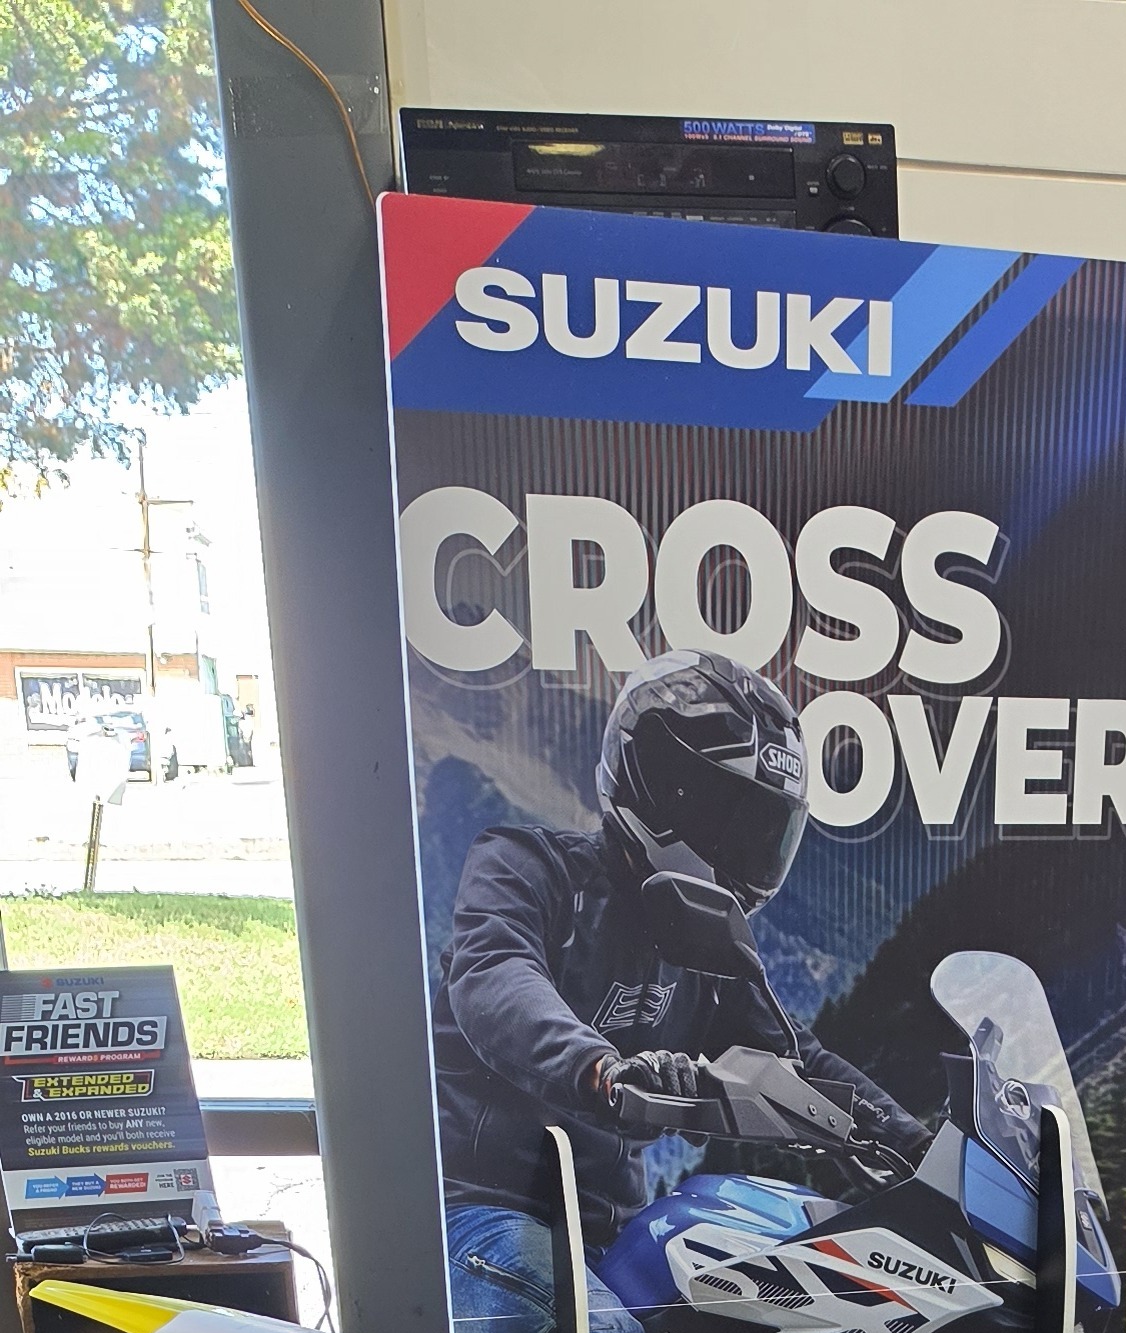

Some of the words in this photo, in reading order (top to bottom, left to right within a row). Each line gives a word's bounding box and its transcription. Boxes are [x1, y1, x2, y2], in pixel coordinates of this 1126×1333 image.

[684, 120, 710, 133] 500
[712, 122, 765, 135] WATTS
[454, 267, 894, 376] SUZUKI
[398, 486, 1003, 686] CROSS
[56, 977, 105, 987] SUZUKI
[33, 991, 120, 1021] FAST
[4, 1020, 159, 1052] FRIENDS
[100, 1052, 141, 1061] PROGRAM
[33, 1073, 135, 1087] EXTENDED
[33, 1088, 43, 1099] &
[48, 1083, 150, 1097] EXPANDED
[22, 1113, 44, 1123] OWN
[46, 1112, 53, 1121] A
[55, 1111, 77, 1121] 2016
[79, 1110, 93, 1119] OR
[94, 1108, 126, 1119] NEWER
[128, 1106, 166, 1117] SUZUKI?
[24, 1124, 46, 1134] Refer
[48, 1125, 66, 1135] your
[68, 1121, 97, 1132] friends
[98, 1121, 107, 1130] to
[109, 1120, 124, 1132] buy
[126, 1119, 143, 1128] ANY
[26, 1135, 56, 1147] eligible
[58, 1132, 84, 1143] model
[86, 1130, 101, 1142] and
[103, 1130, 124, 1143] you'll
[126, 1128, 145, 1139] both
[146, 1129, 176, 1139] receive
[28, 1146, 60, 1156] Suzuki
[63, 1144, 91, 1154] Bucks
[93, 1142, 129, 1152] rewards
[131, 1140, 176, 1151] vouchers.
[867, 1251, 957, 1295] SUZUKI
